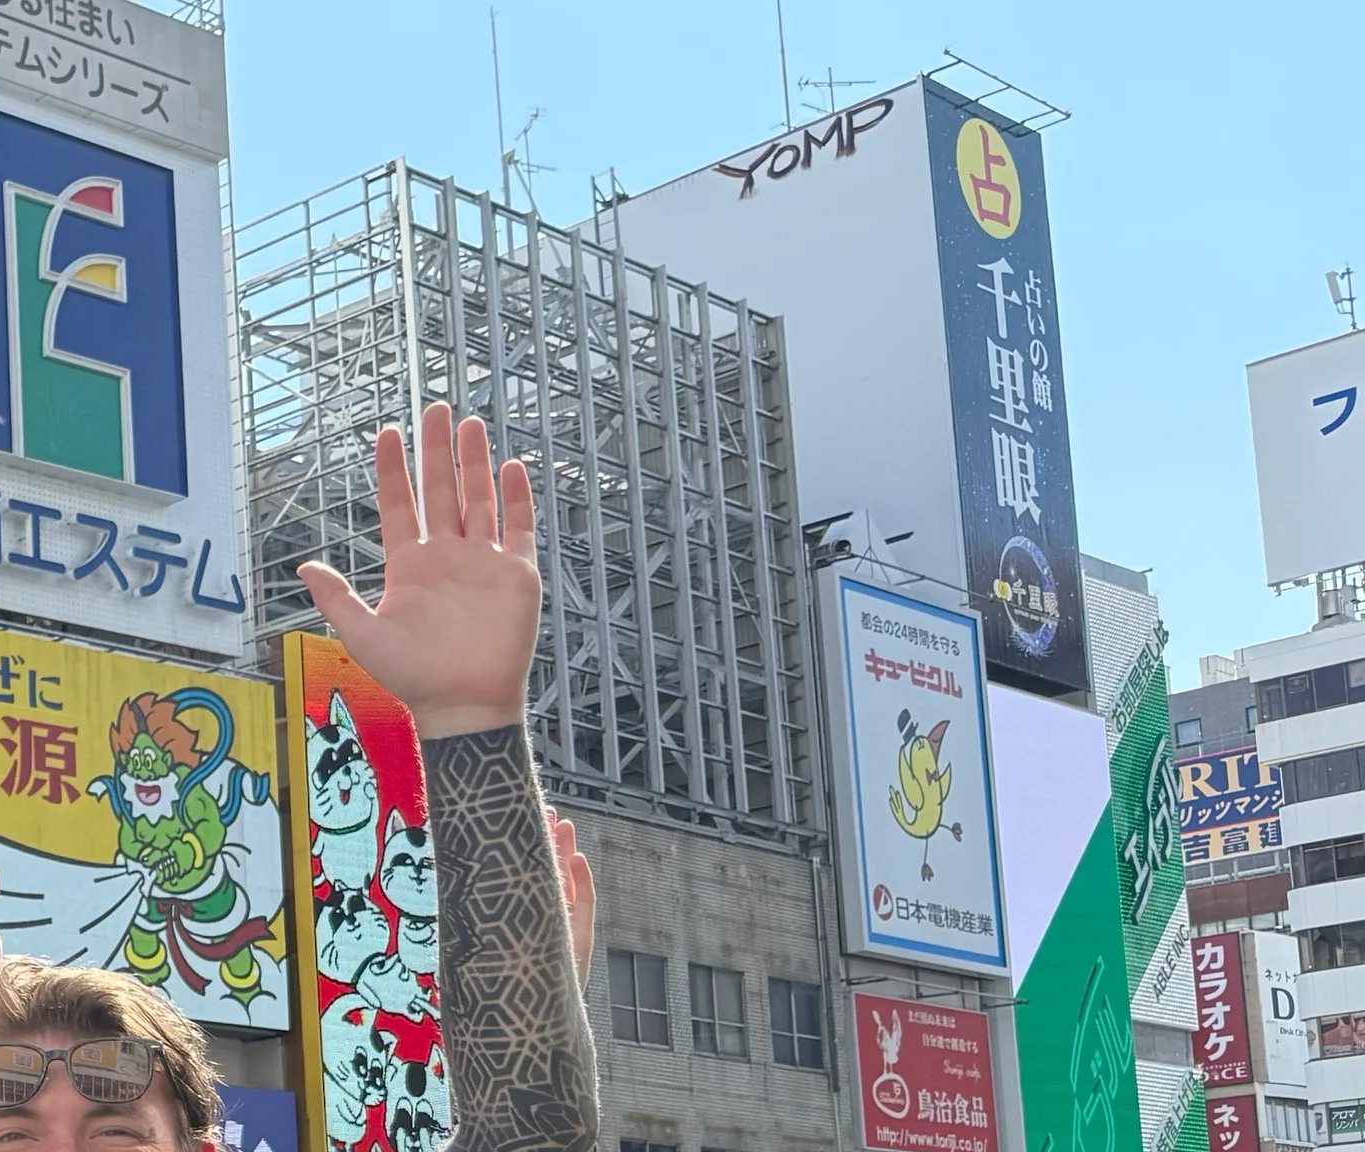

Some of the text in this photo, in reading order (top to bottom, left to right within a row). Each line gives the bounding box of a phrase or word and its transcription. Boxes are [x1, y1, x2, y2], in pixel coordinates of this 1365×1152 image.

[970, 123, 1013, 228] 占
[1021, 269, 1053, 413] 占いの館
[976, 256, 1043, 525] 千里眼
[1312, 386, 1359, 437] フ
[860, 611, 960, 656] 都会の24時間を守る
[864, 648, 963, 699] キュービクル
[895, 896, 995, 937] 日本電機産業
[1196, 941, 1235, 1062] カラオケ
[1331, 1109, 1356, 1121] アロマ
